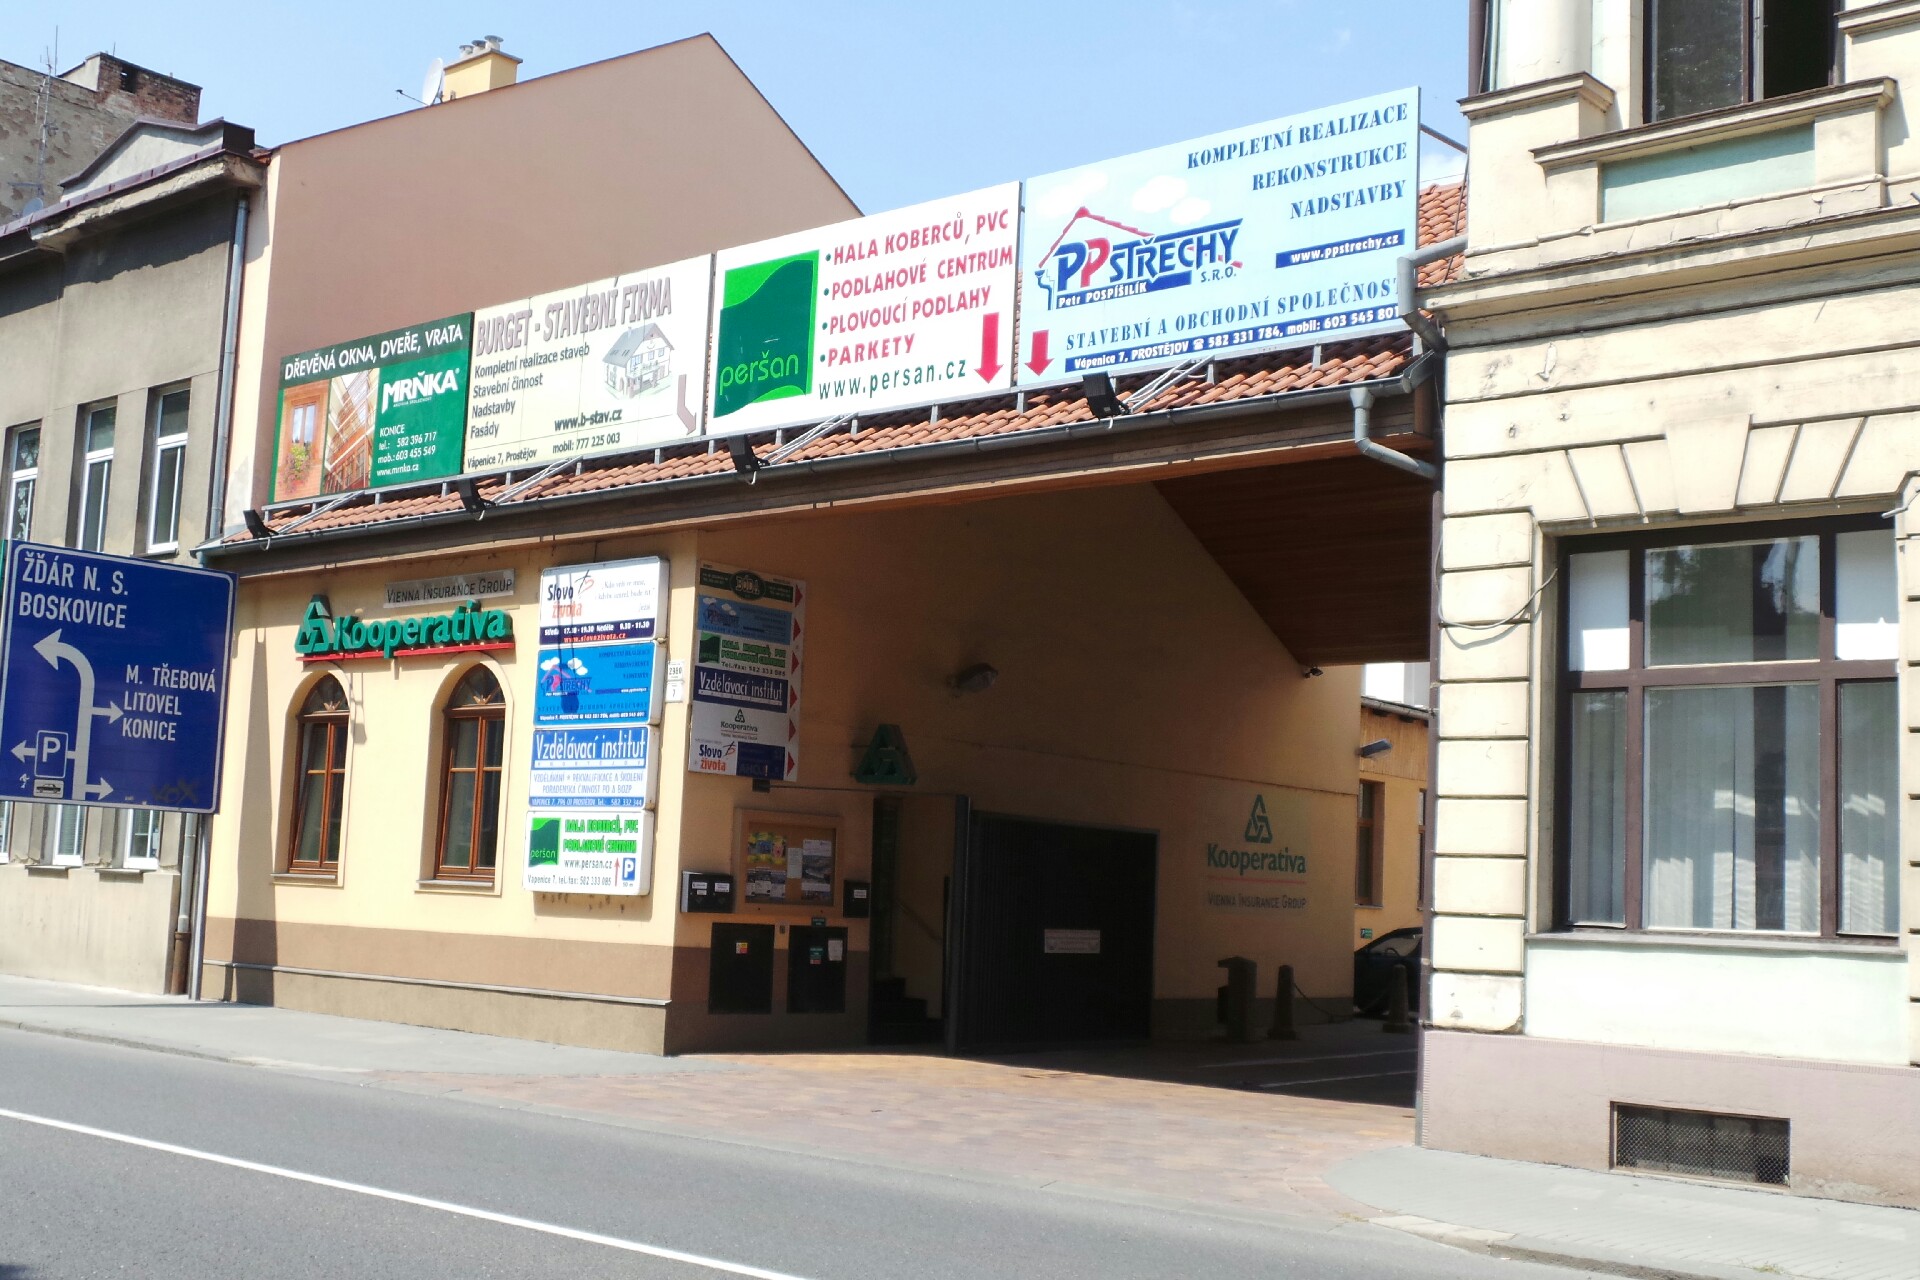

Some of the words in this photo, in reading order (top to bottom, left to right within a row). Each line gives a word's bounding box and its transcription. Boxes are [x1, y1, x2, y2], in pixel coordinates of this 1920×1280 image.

[1187, 126, 1293, 169] KOMPLETNÍ
[1299, 102, 1408, 144] REALIZACE
[1251, 142, 1408, 191] REKONSTRUKCE
[1290, 179, 1408, 219] NADSTAVBY
[834, 238, 878, 265] HALA
[885, 211, 970, 254] KOBERCŮ,
[976, 209, 1009, 235] PVC
[1291, 233, 1399, 264] www.ppstrechy.cz
[831, 257, 927, 300] PODLAHOVÉ
[937, 245, 1013, 280] CENTRUM
[829, 296, 908, 334] PLOVOUCÍ
[912, 285, 991, 320] PODLAHY
[1058, 292, 1081, 308] Petr
[1085, 281, 1147, 303] POSPÍŠILÍK
[476, 309, 532, 356] BURGET
[543, 277, 619, 342] STAVEBNÍ
[621, 277, 672, 324] FIRMA
[1066, 316, 1151, 351] STAVEBNÍ
[1158, 318, 1168, 335] A
[1175, 295, 1271, 332] OBCHODNÍ
[285, 349, 336, 380] DŘEVĚNÁ
[339, 345, 376, 368] OKNA,
[380, 331, 421, 358] DVEŘE,
[425, 323, 463, 347] VRATA
[828, 333, 915, 367] PARKETY
[1074, 353, 1116, 370] Vápenice
[1119, 350, 1128, 365] 7,
[1131, 339, 1189, 360] PROSTĚJOV
[1208, 334, 1230, 348] 582
[1233, 329, 1254, 345] 331
[1257, 325, 1283, 341] 784,
[1287, 320, 1320, 336] mobil:
[1324, 315, 1347, 330] 603
[1351, 310, 1373, 325] 545
[474, 355, 518, 379] Kompletní
[519, 349, 558, 368] realizace
[560, 343, 590, 362] staveb
[720, 350, 799, 396] peršan
[473, 379, 509, 399] Stavební
[512, 373, 543, 391] činnost
[819, 359, 966, 399] www.persan.cz
[472, 398, 516, 419] Nadstavby
[554, 409, 623, 432] www.b-stav.cz
[379, 424, 405, 437] KONICE
[379, 438, 390, 450] tel.:
[397, 437, 409, 447] 582
[410, 435, 422, 445] 396
[424, 432, 437, 442] 717
[470, 421, 499, 439] Fasády
[378, 451, 395, 464] mob.:
[396, 450, 408, 460] 603
[409, 447, 422, 458] 455
[423, 445, 435, 456] 549
[468, 453, 496, 469] Vápenice
[498, 451, 504, 463] 7,
[506, 447, 537, 463] Prostějov
[553, 441, 574, 454] mobil:
[576, 437, 589, 450] 777
[591, 434, 605, 446] 225
[606, 432, 620, 444] 003
[377, 463, 419, 476] www.mrnka.cz
[22, 550, 74, 589] ŽĎÁR
[83, 568, 101, 592] N.
[111, 570, 128, 596] S.
[387, 588, 420, 603] VIENNA
[423, 582, 475, 600] INSURANCE
[478, 577, 512, 594] GROUP
[547, 583, 574, 601] Slovo
[19, 592, 127, 629] BOSKOVICE
[333, 599, 509, 659] Kooperativa
[126, 664, 143, 685] M.
[152, 663, 216, 693] TŘEBOVÁ
[700, 672, 748, 695] Vzdělávací
[752, 680, 782, 700] institut
[124, 691, 182, 716] LITOVEL
[122, 718, 176, 741] KONICE
[720, 721, 758, 732] Kooperativa
[42, 737, 61, 762] P
[536, 734, 597, 761] Vzdělávací
[602, 730, 646, 759] institut
[699, 744, 722, 758] Slovo
[700, 758, 726, 771] života
[564, 860, 612, 869] www.persan.cz
[624, 859, 634, 878] P
[1207, 843, 1307, 875] Kooperativa
[1208, 892, 1236, 907] VIENNA
[1238, 892, 1280, 909] INSURANCE
[1281, 894, 1307, 910] GROUP
